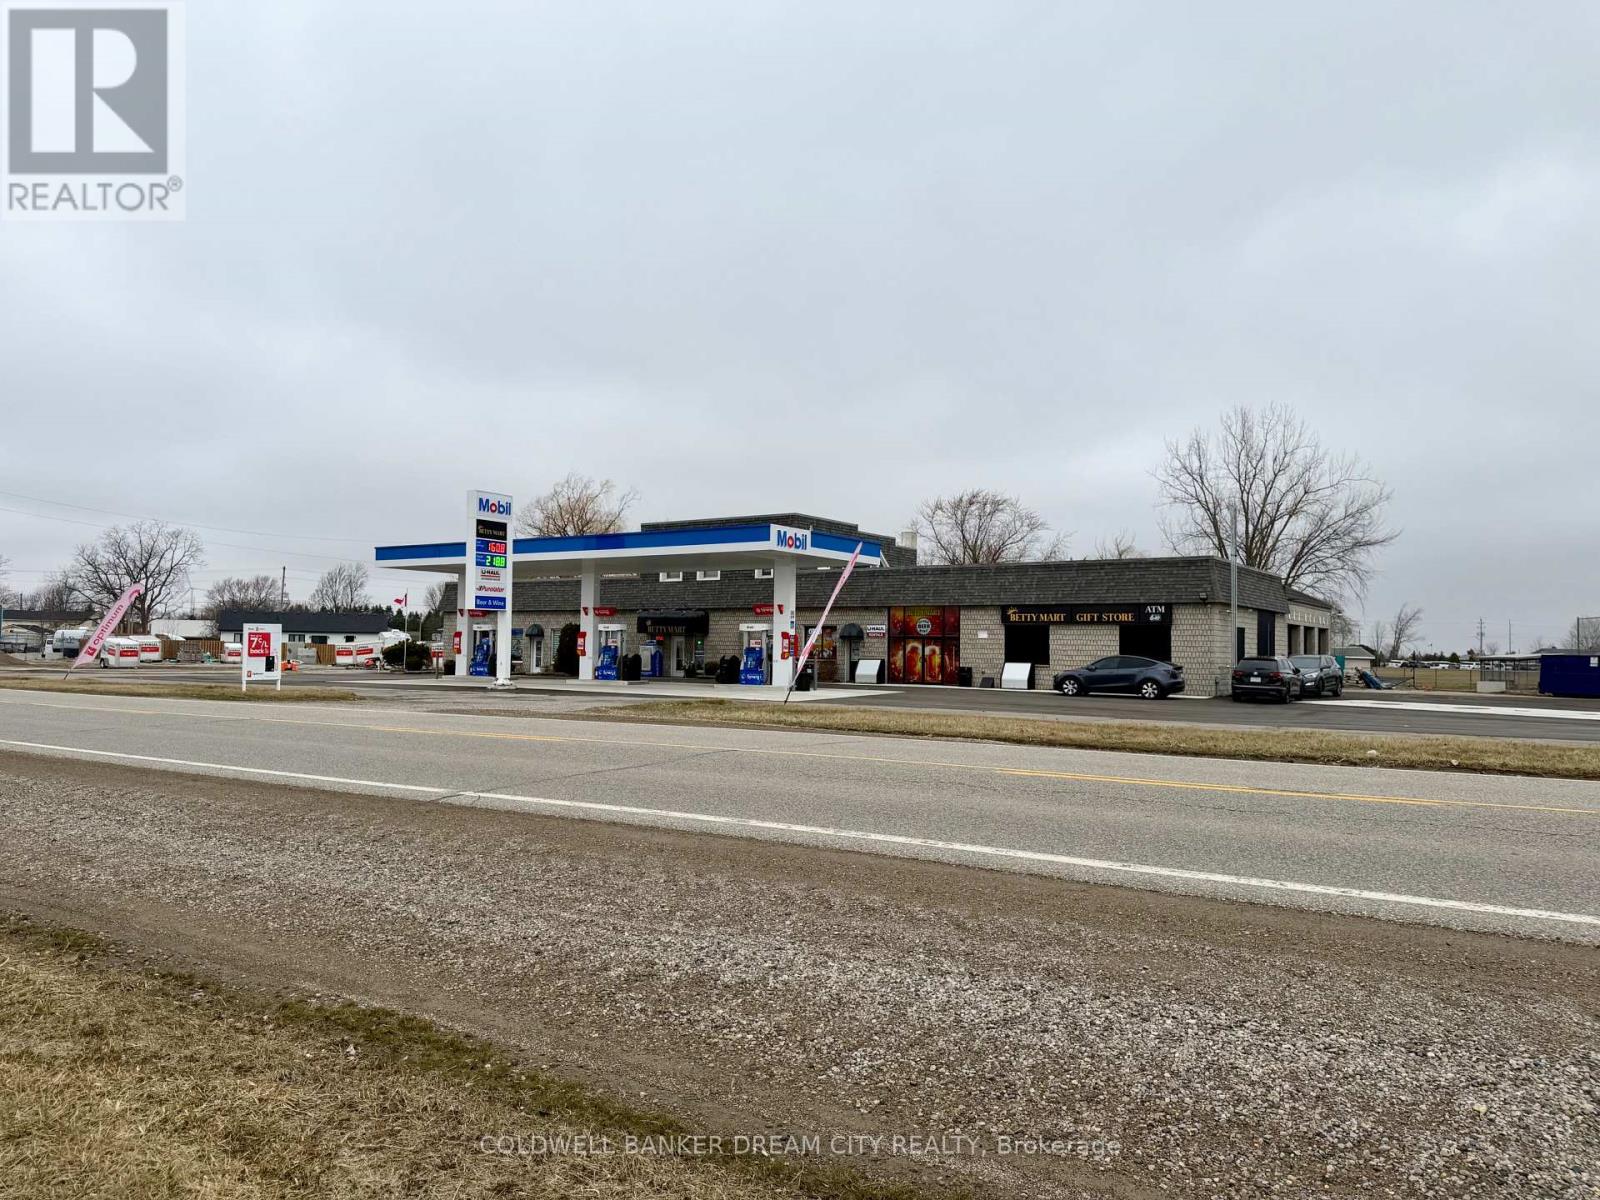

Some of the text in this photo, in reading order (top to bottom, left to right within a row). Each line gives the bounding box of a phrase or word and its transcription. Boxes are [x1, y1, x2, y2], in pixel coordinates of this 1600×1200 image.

[478, 497, 512, 516] Mobil
[776, 529, 808, 550] Mobil
[1010, 612, 1135, 622] BETTY MART GIFT STORE
[1145, 605, 1166, 613] ATM
[93, 604, 124, 645] optimum
